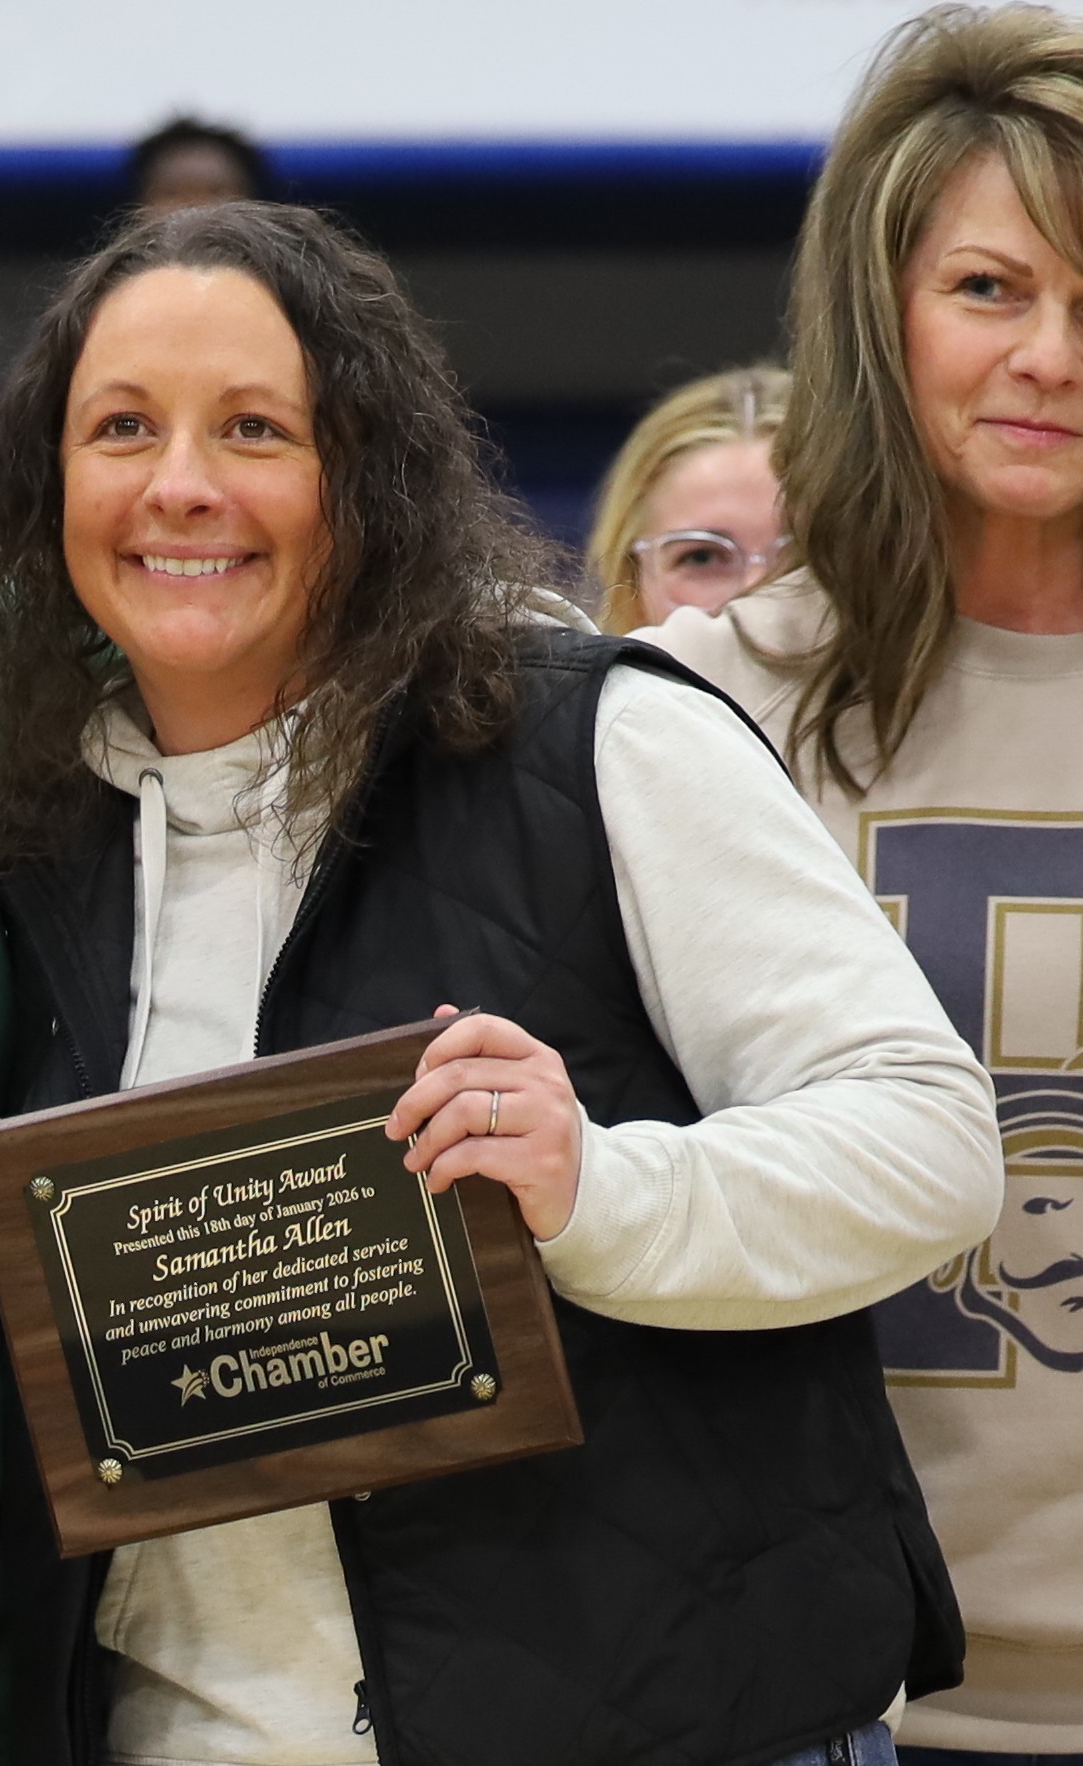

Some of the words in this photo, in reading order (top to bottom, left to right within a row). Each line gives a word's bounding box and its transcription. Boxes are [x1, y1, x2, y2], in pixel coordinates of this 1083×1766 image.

[113, 1228, 175, 1256] Presented
[176, 1224, 201, 1241] this
[203, 1217, 232, 1235] 18th
[233, 1213, 256, 1229] day
[259, 1206, 274, 1222] of
[276, 1198, 324, 1219] January
[326, 1186, 360, 1207] 2026
[360, 1186, 375, 1199] to
[126, 1196, 184, 1235] Spirit
[188, 1184, 210, 1222] of
[212, 1177, 274, 1207] Unity
[278, 1153, 347, 1194] Award
[109, 1299, 126, 1318] In
[129, 1281, 218, 1313] recognition
[222, 1270, 241, 1294] of
[242, 1269, 268, 1287] her
[272, 1246, 349, 1280] dedicated
[352, 1237, 408, 1262] service
[152, 1228, 279, 1282] Samantha
[282, 1213, 352, 1251] Allen
[105, 1318, 135, 1341] and
[138, 1302, 231, 1334] unwavering
[234, 1277, 329, 1312] commitment
[333, 1274, 349, 1290] to
[351, 1258, 424, 1290] fostering
[121, 1340, 167, 1366] peace
[171, 1327, 201, 1350] and
[204, 1315, 274, 1343] harmony
[277, 1302, 332, 1325] among
[335, 1291, 356, 1312] all
[360, 1280, 417, 1312] people.
[209, 1331, 389, 1398] Chamber
[248, 1336, 319, 1360] Independence
[317, 1376, 329, 1389] of
[330, 1366, 386, 1387] Commerce
